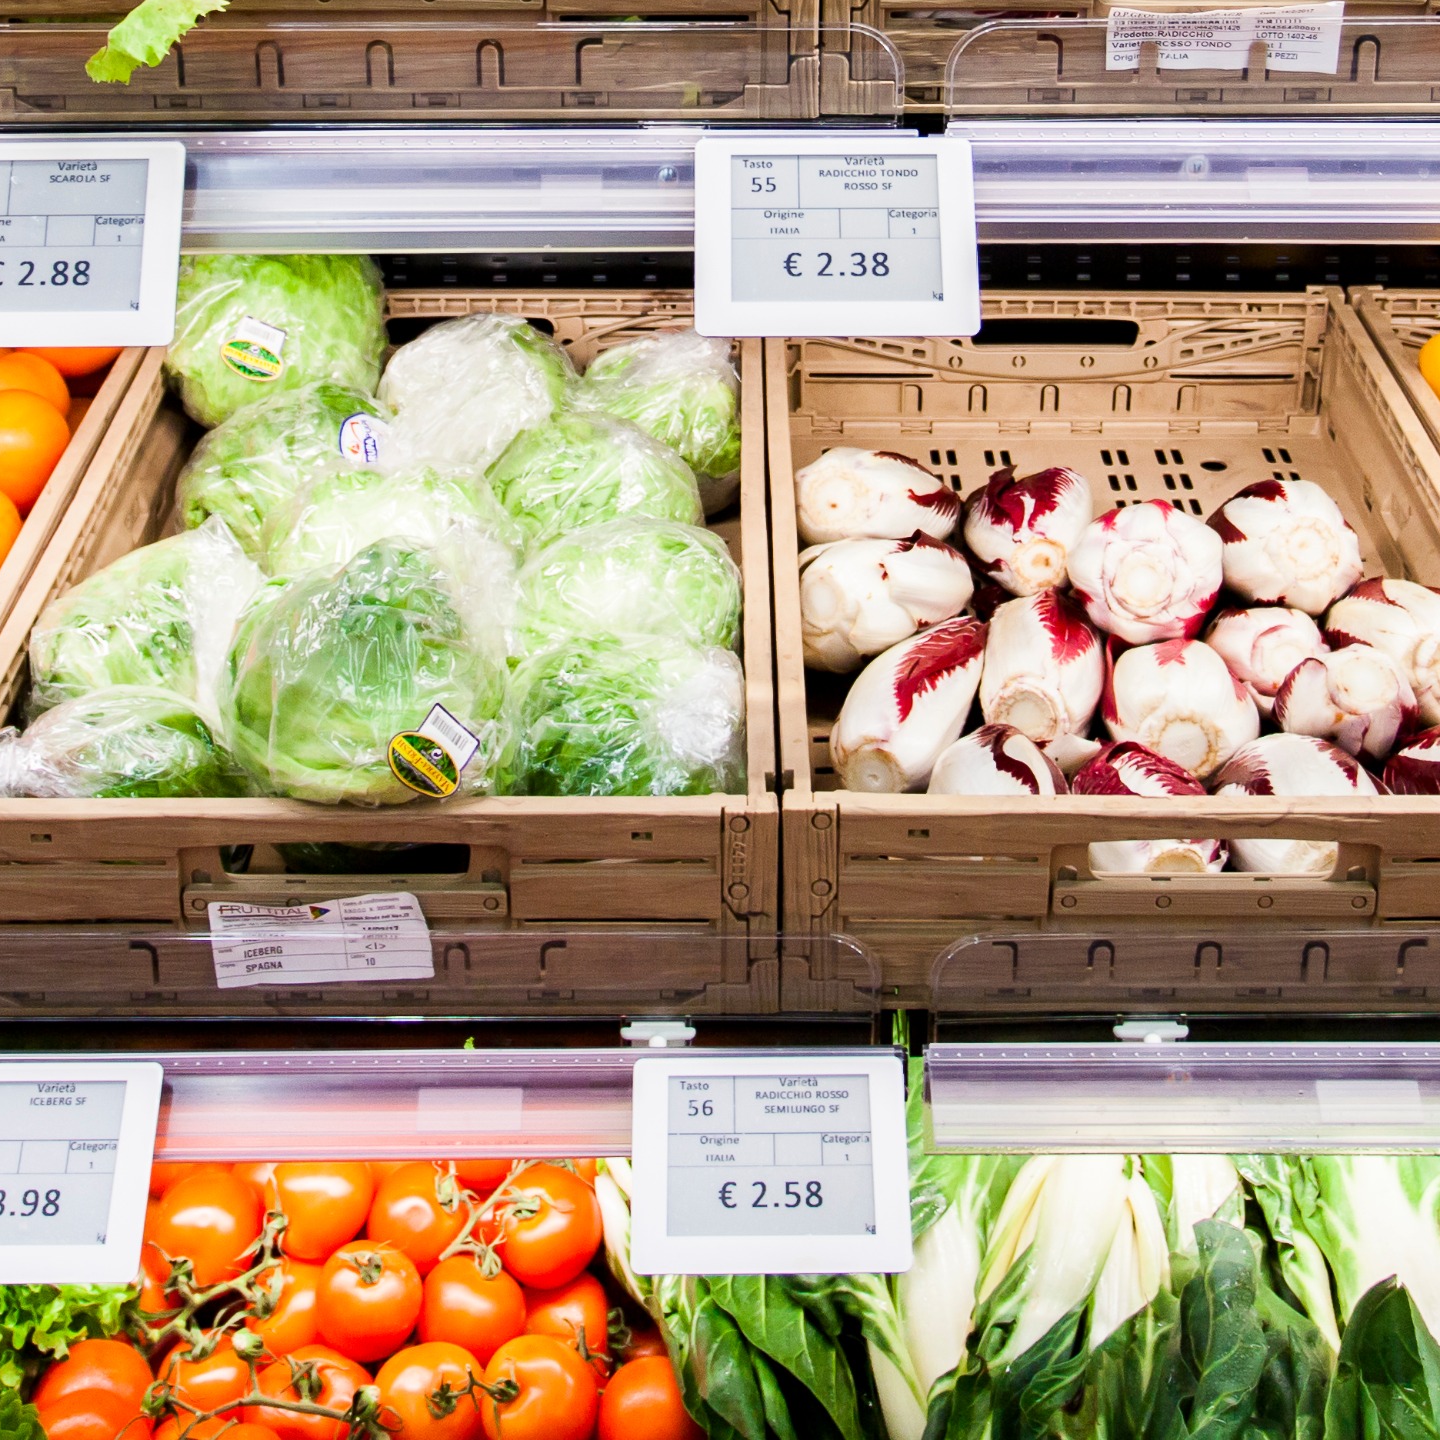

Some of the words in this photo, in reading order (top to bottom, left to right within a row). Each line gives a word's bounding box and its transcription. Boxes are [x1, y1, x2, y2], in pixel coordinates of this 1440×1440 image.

[1196, 40, 1232, 49] TONDO
[1274, 52, 1298, 60] PEZZI
[742, 160, 773, 170] Tasto
[844, 156, 884, 166] Varietà
[58, 161, 98, 172] Varietà
[49, 174, 96, 183] SCAROLA
[100, 174, 111, 183] SF
[818, 169, 876, 178] RADICCHIO
[880, 169, 918, 178] TONDO
[750, 176, 776, 193] 55
[844, 182, 878, 191] ROSSO
[882, 182, 893, 191] SF
[763, 210, 804, 220] Origine
[94, 216, 144, 227] Categoria
[770, 226, 800, 235] ITALIA
[782, 252, 802, 277] €
[816, 252, 890, 277] 2.38
[18, 260, 90, 286] 2.88
[243, 946, 284, 958] ICEBERG
[245, 961, 283, 973] SPAGNA
[365, 958, 376, 966] 10
[680, 1081, 710, 1091] Tasto
[778, 1076, 818, 1087] Varietà
[37, 1082, 76, 1094] Varietà
[756, 1090, 812, 1100] RADICCHIO
[816, 1090, 849, 1100] ROSSO
[30, 1096, 72, 1106] ICEBERG
[75, 1096, 87, 1106] SF
[688, 1098, 714, 1116] 56
[764, 1104, 826, 1114] SEMILUNGO
[829, 1104, 840, 1114] SF
[70, 1141, 117, 1152] Categoria
[706, 1154, 736, 1162] ITALIA
[718, 1180, 738, 1208] €
[751, 1180, 824, 1208] 2.58
